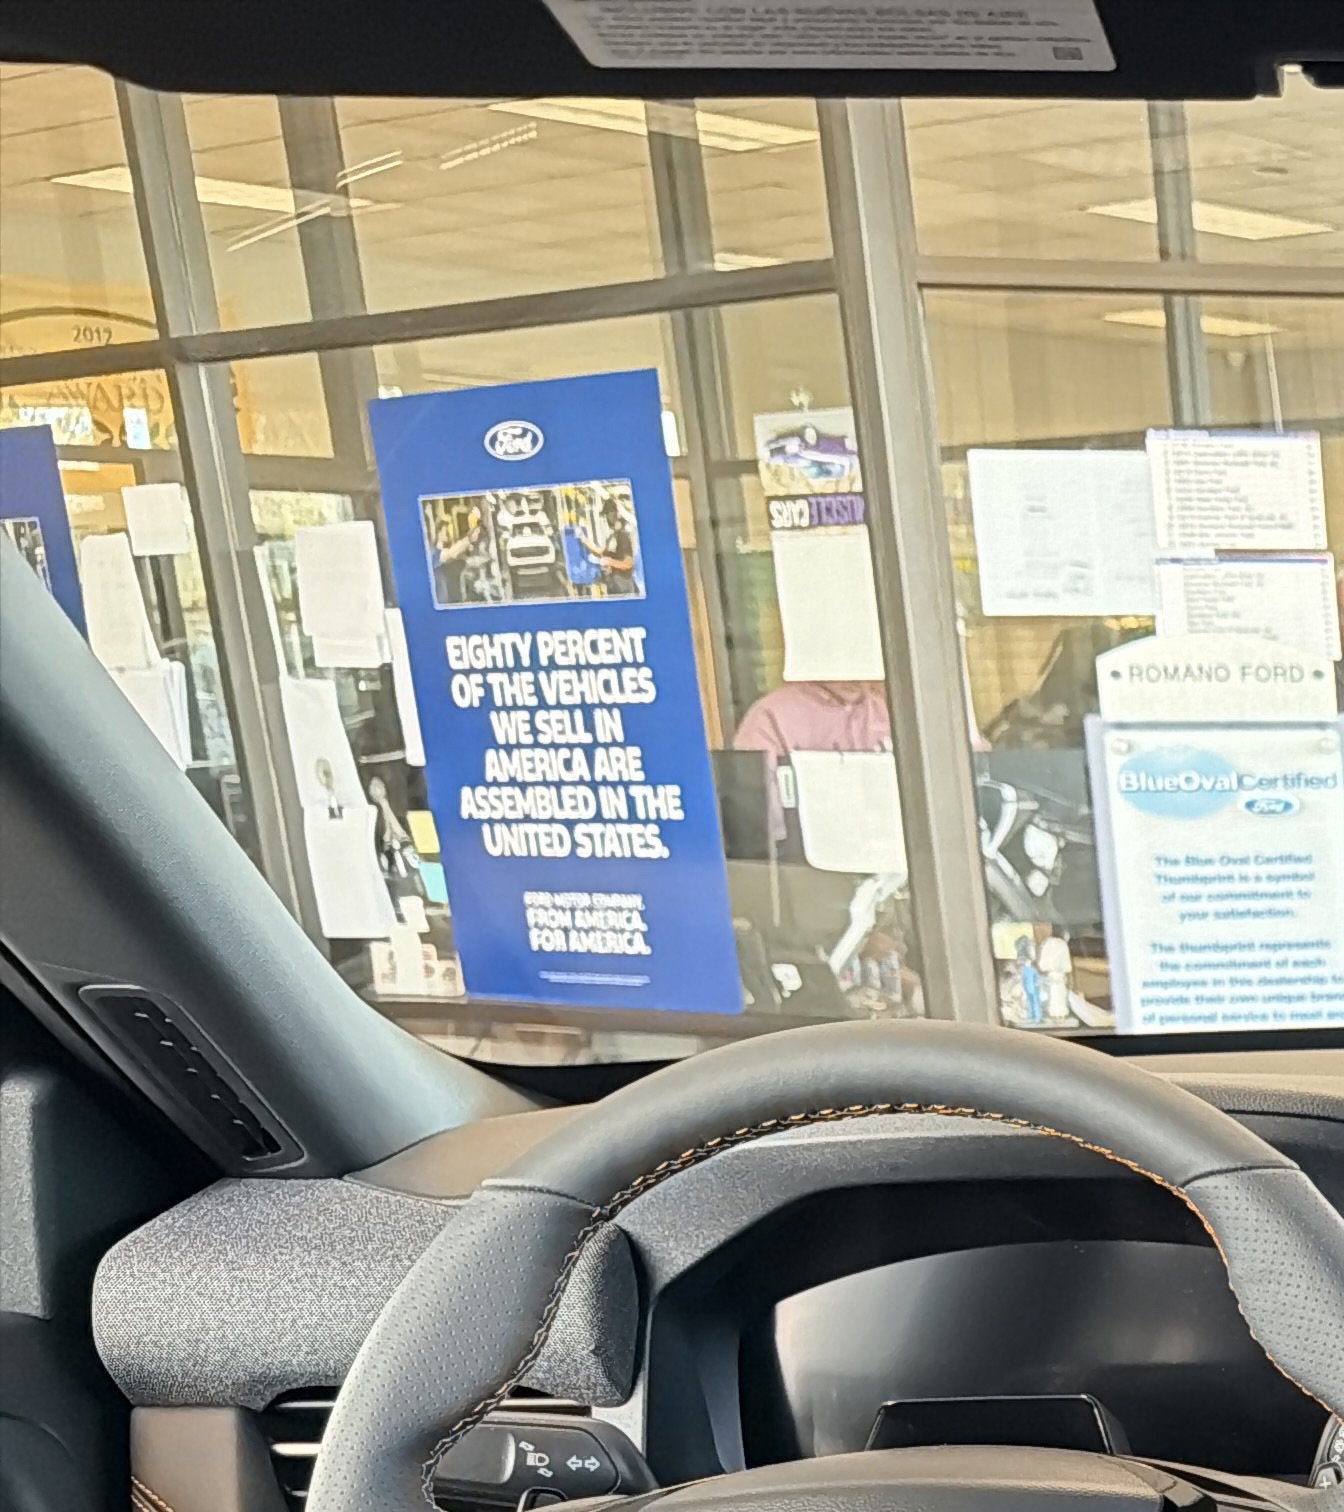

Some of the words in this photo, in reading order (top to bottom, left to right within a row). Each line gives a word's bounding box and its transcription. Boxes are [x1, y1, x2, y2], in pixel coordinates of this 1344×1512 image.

[769, 499, 810, 528] CARS
[446, 632, 532, 670] EIGHTY
[536, 627, 647, 666] PERCENT
[452, 673, 485, 708] OF
[487, 672, 539, 706] THE
[538, 667, 656, 706] VEHICLES
[1128, 663, 1231, 684] ROMANO
[1240, 663, 1305, 684] FORD
[490, 709, 534, 744] WE
[534, 708, 593, 744] SELL
[593, 708, 624, 743] IN
[485, 747, 591, 782] AMERICA
[594, 746, 645, 782] ARE
[460, 786, 597, 820] ASSEMBLED
[600, 785, 629, 819] IN
[629, 785, 685, 820] THE
[482, 823, 571, 857] UNITED
[574, 823, 670, 859] STATES.
[1155, 855, 1180, 865] The
[1184, 855, 1214, 865] Blue
[1219, 855, 1249, 865] Oval
[1254, 854, 1313, 864] Certified
[526, 907, 572, 928] FROM
[574, 909, 649, 932] AMERICA.
[529, 927, 567, 952] FOR
[568, 928, 653, 955] AMERICA.
[1151, 943, 1175, 953] The
